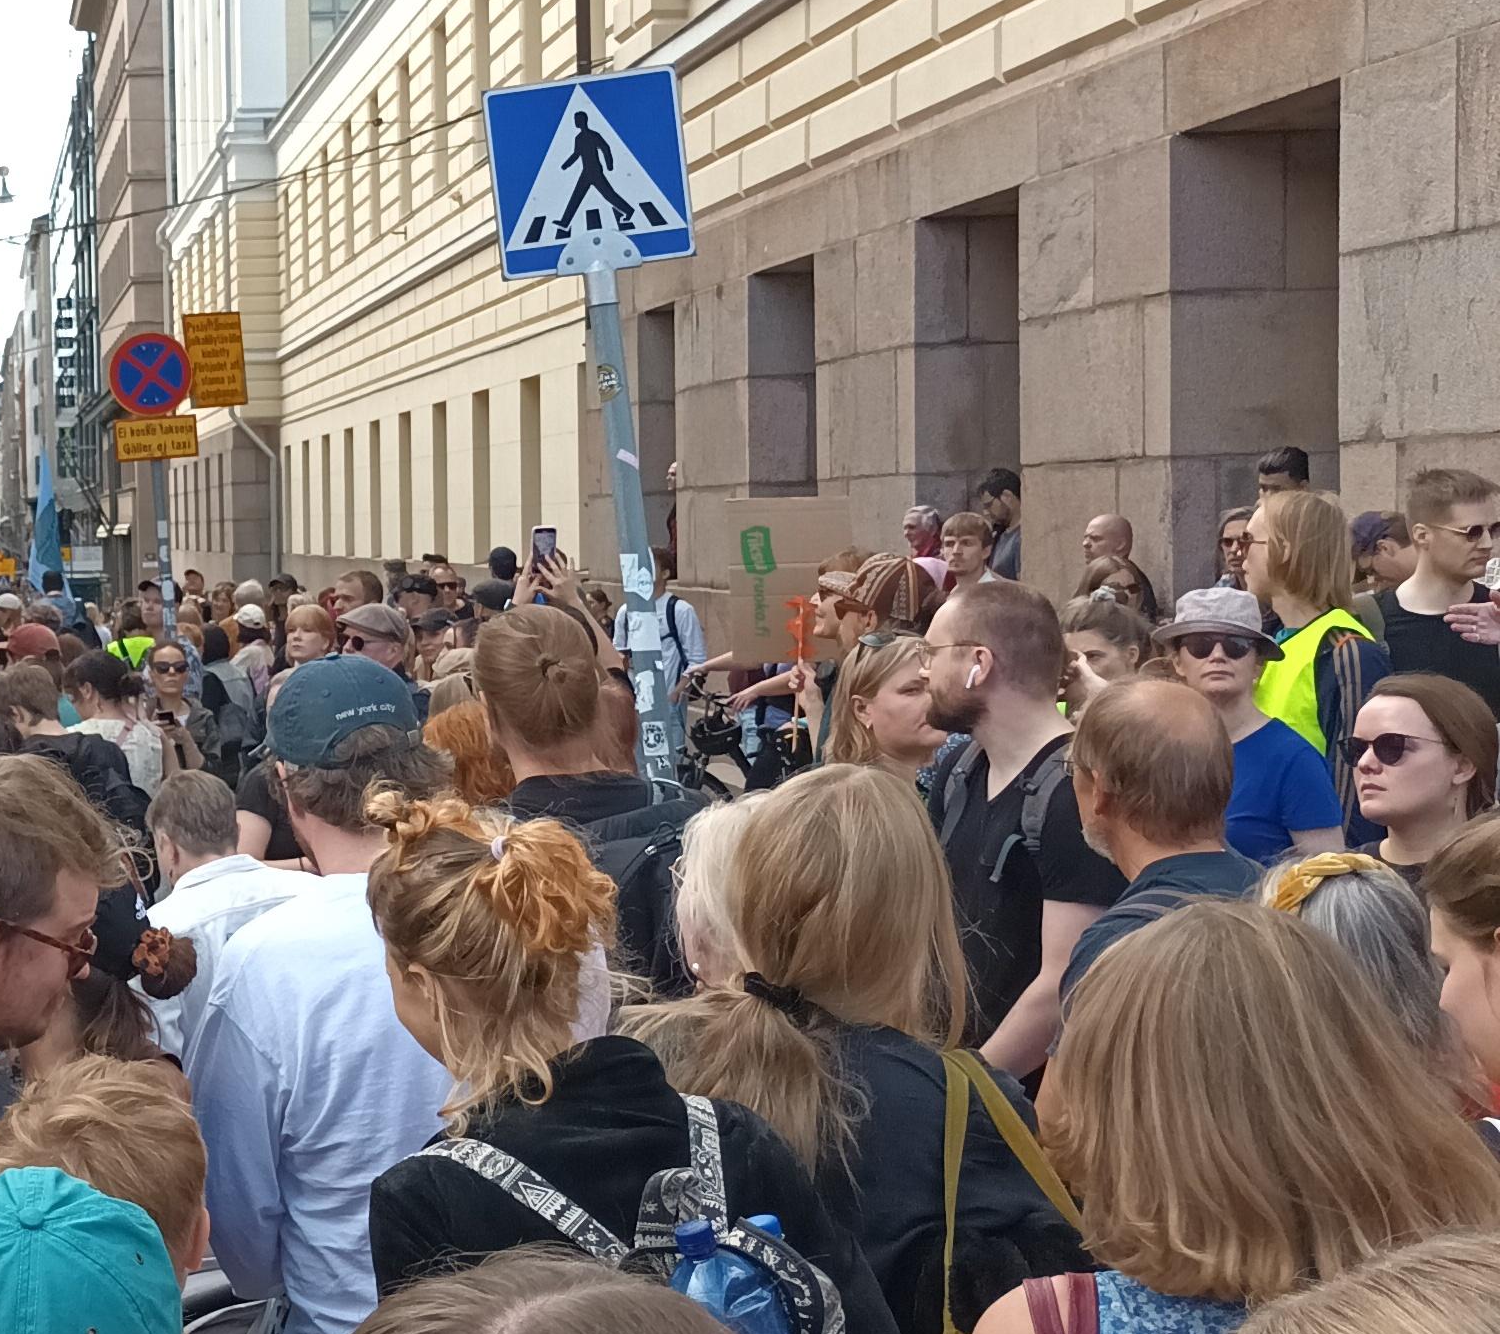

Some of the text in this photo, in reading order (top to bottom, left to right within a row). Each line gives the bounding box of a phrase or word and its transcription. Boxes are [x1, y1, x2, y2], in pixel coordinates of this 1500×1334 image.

[118, 427, 126, 438] Ei
[130, 424, 156, 437] koske
[123, 440, 191, 455] Gäller ej taxi
[335, 703, 396, 720] new york city
